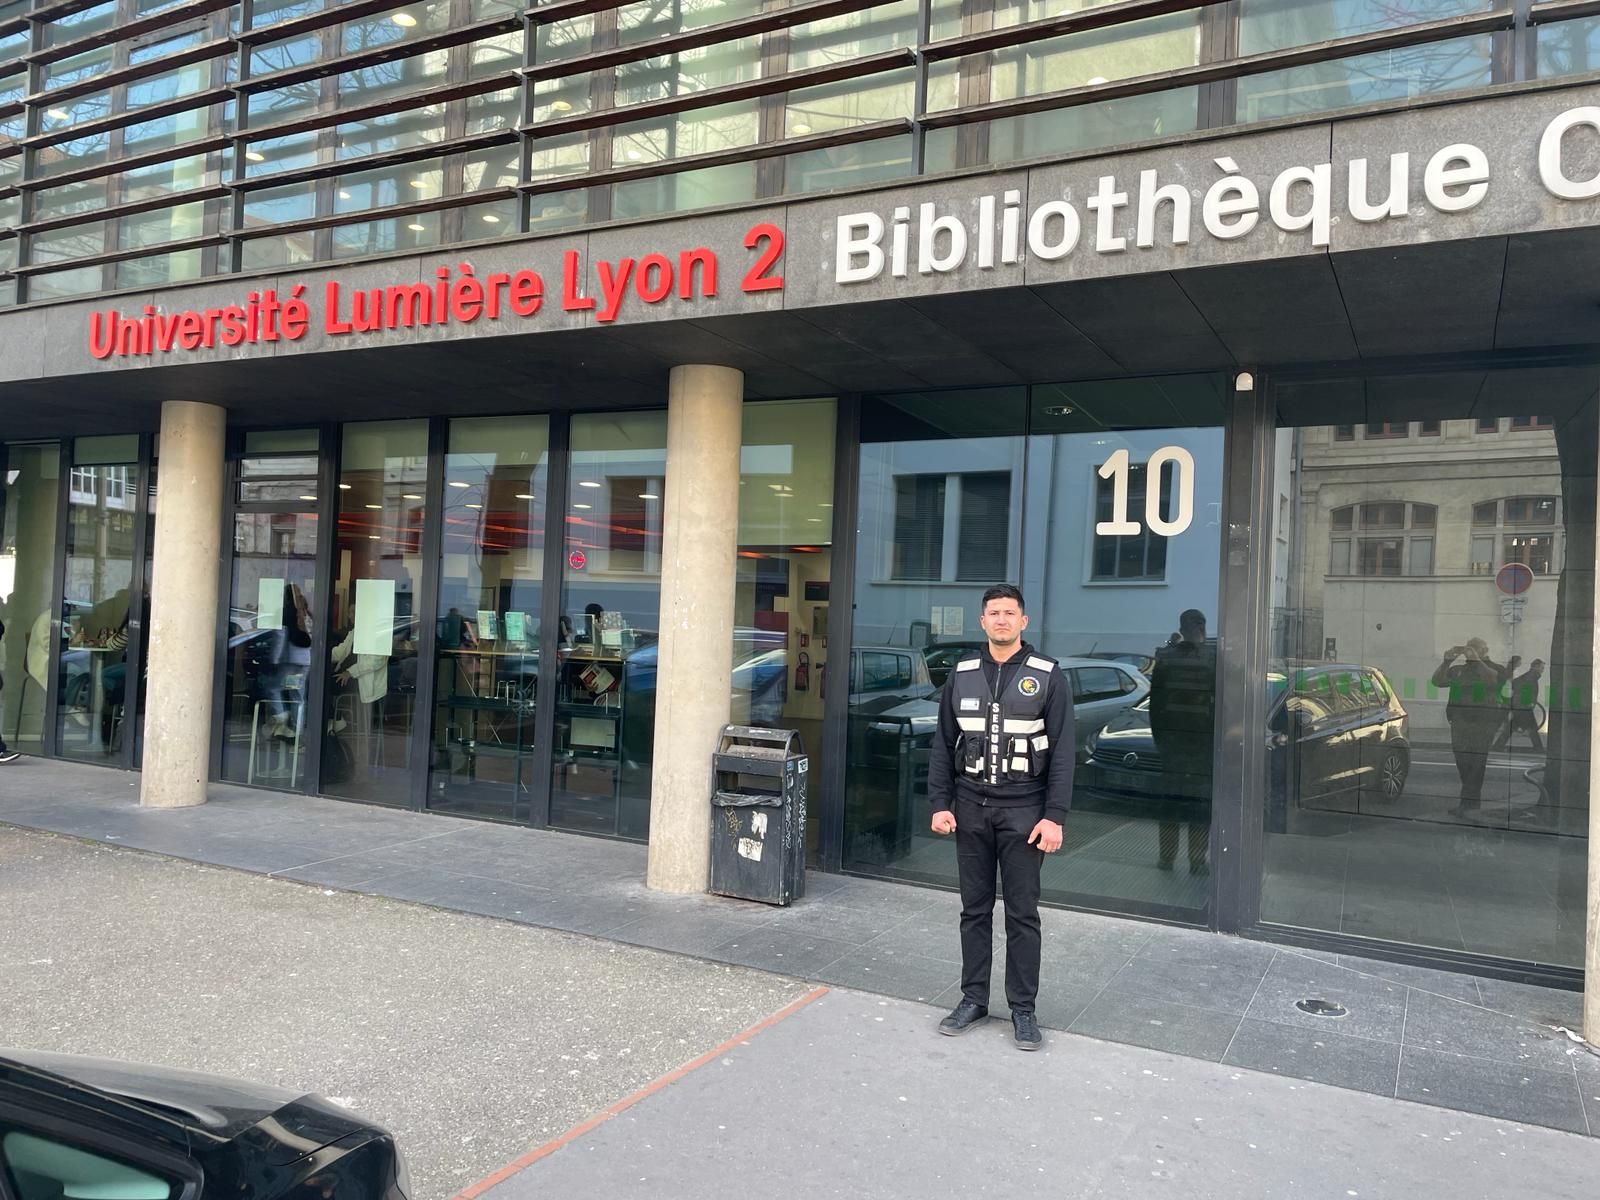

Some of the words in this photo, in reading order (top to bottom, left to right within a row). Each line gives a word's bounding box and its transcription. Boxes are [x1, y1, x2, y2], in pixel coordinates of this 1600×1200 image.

[835, 142, 1490, 285] Bibliothèque
[89, 285, 309, 359] Université
[324, 261, 544, 334] Lumière
[562, 247, 717, 322] Lyon
[741, 223, 784, 292] 2
[1095, 445, 1195, 537] 10
[990, 702, 1000, 784] SECURITE
